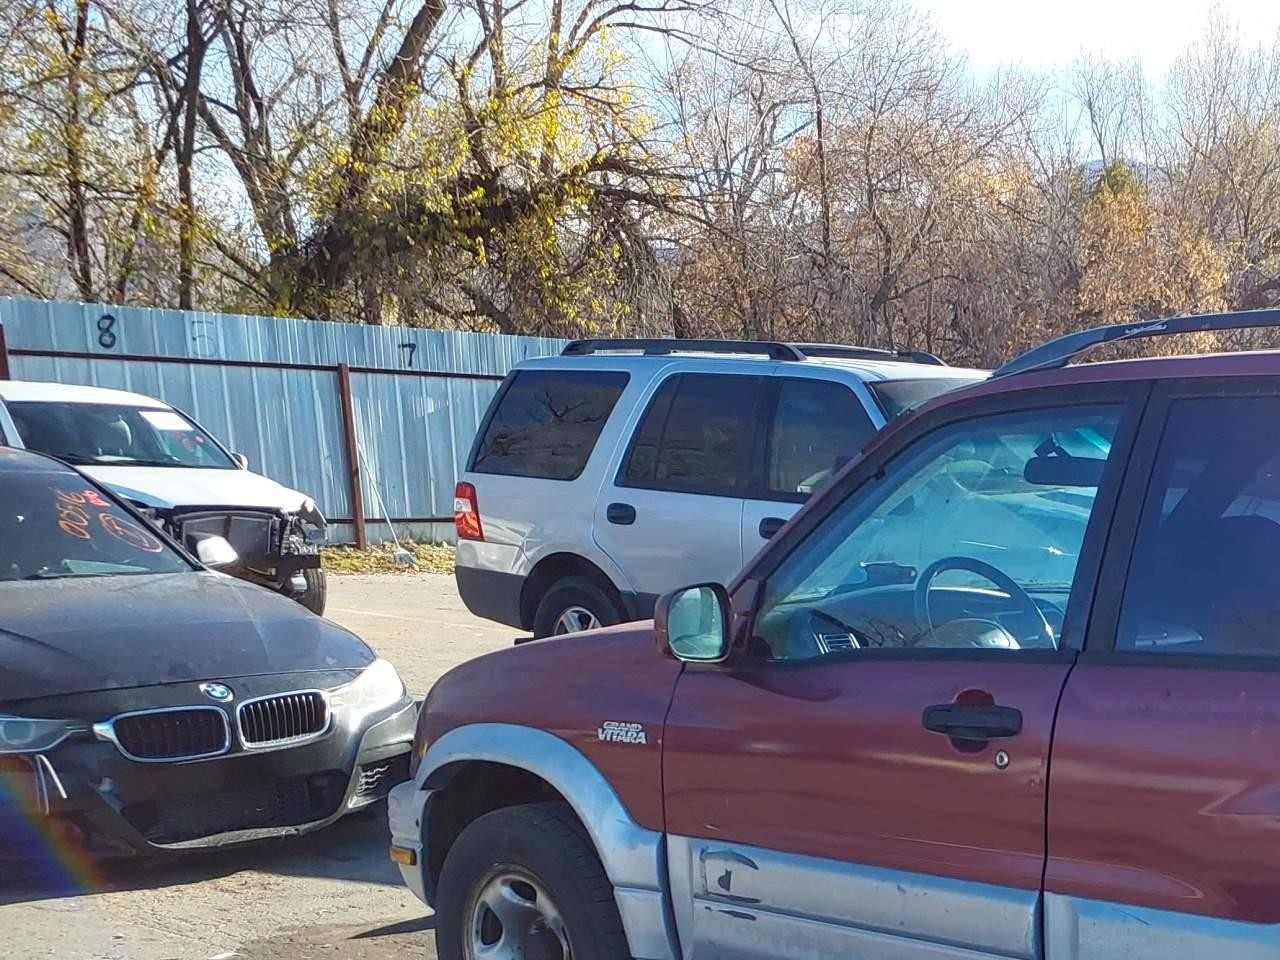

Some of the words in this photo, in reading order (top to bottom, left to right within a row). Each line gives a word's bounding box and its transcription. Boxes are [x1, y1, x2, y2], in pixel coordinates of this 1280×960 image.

[97, 314, 116, 348] 8
[399, 343, 416, 367] 7
[597, 728, 647, 744] VITARA
[603, 721, 643, 731] GRAND
